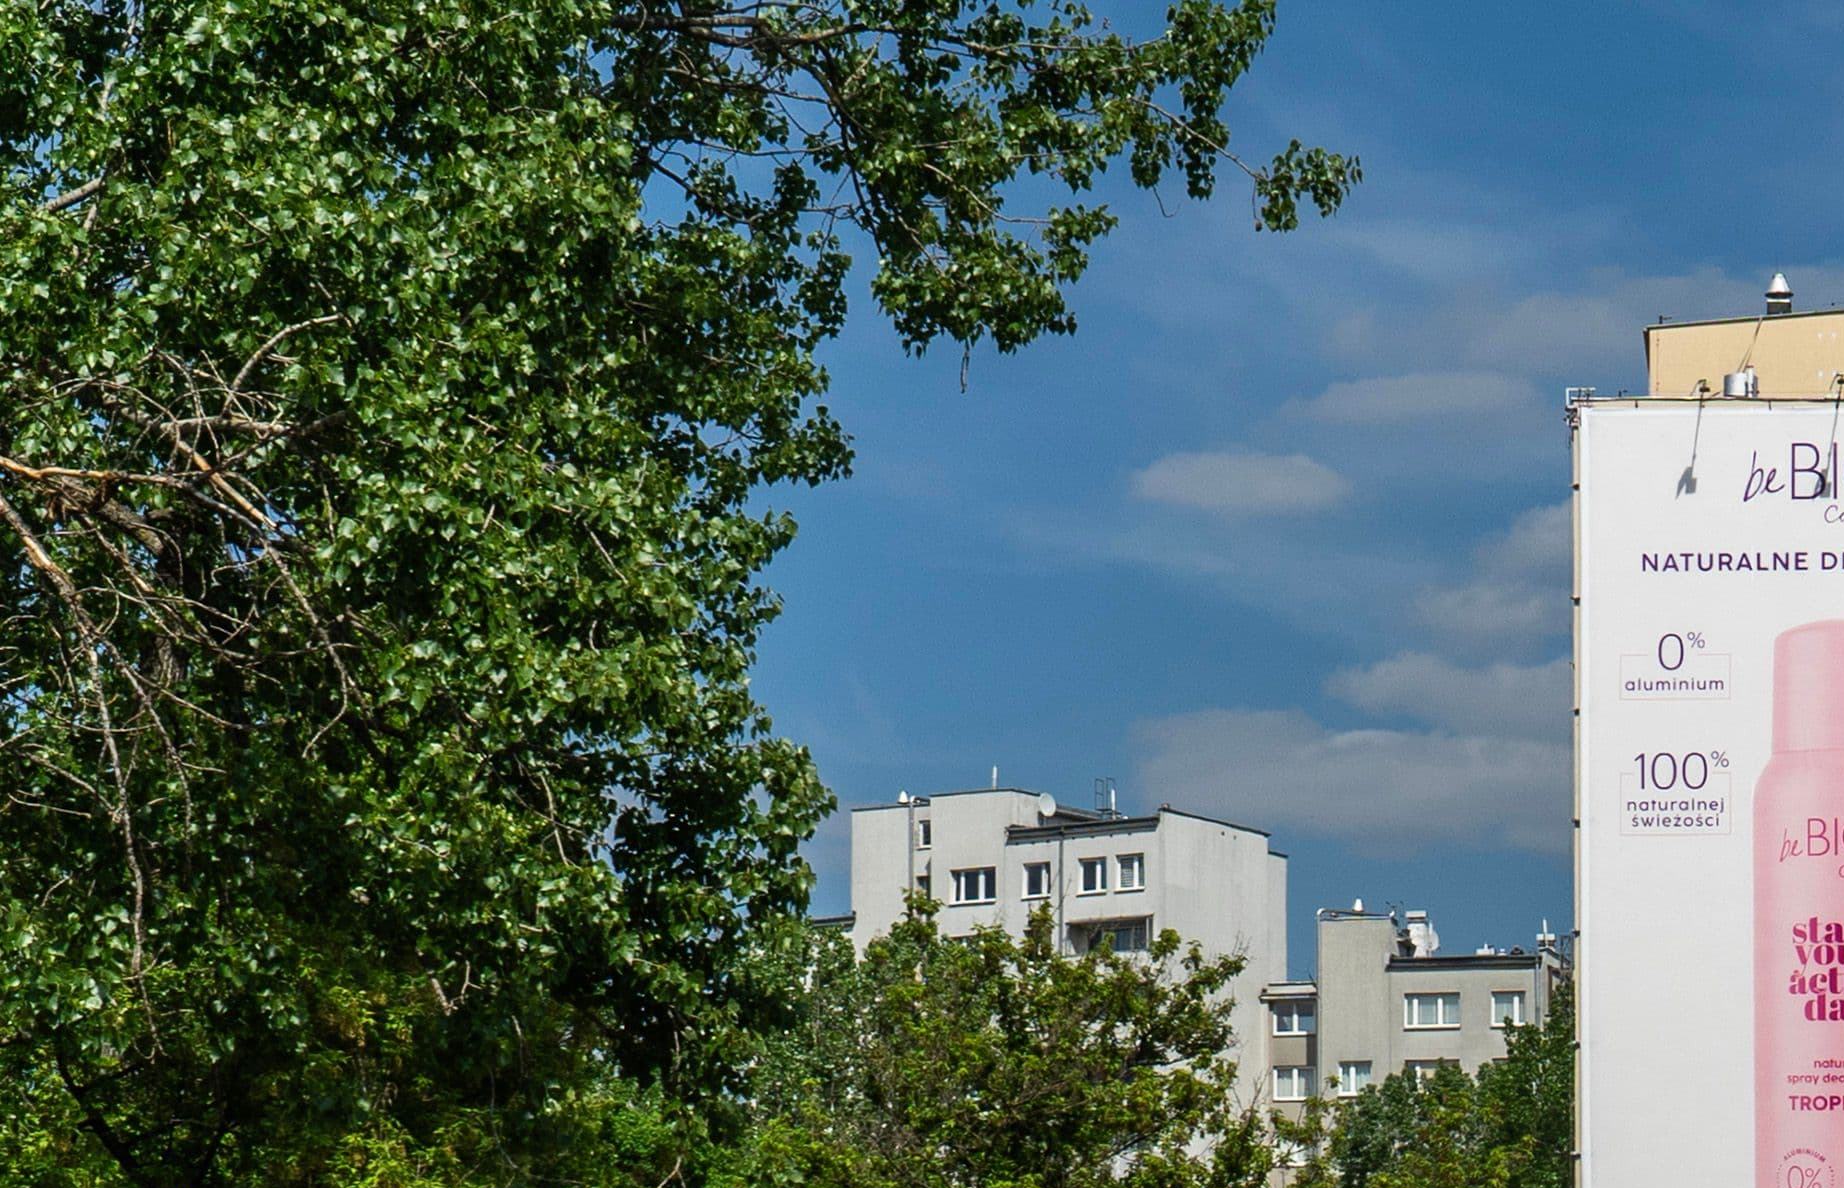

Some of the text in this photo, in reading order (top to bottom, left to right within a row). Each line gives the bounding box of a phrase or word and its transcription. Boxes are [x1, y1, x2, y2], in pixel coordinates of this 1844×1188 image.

[1641, 551, 1809, 572] NATURALNE
[1625, 677, 1725, 692] aluminium
[1634, 751, 1730, 790] 100%
[1627, 798, 1725, 813] naturalnej
[1631, 813, 1720, 828] świeżości
[1787, 1074, 1819, 1084] spray
